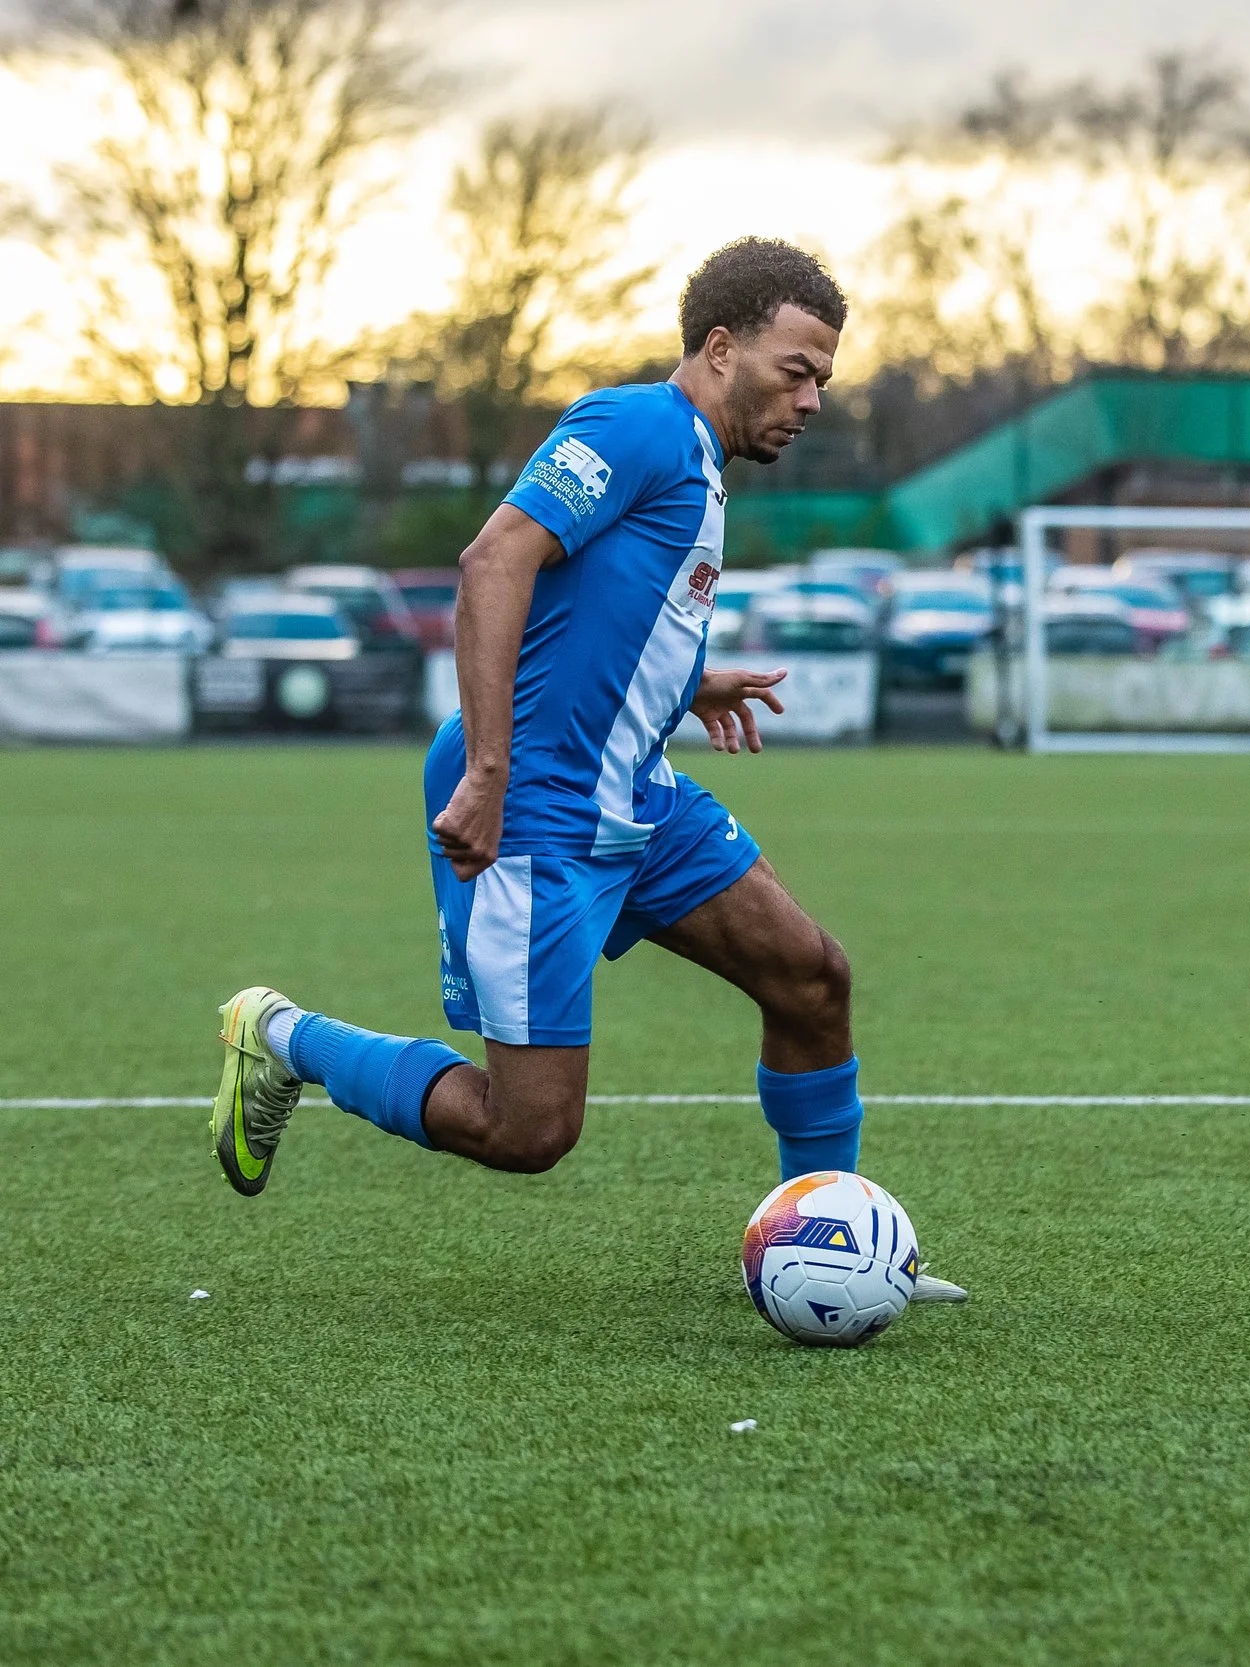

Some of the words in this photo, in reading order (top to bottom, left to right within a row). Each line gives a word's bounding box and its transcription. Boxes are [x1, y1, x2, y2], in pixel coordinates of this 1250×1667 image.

[526, 475, 553, 493] ANYTIME
[533, 468, 575, 500] COURIERS
[573, 497, 587, 515] LTD
[534, 460, 562, 478] CROSS
[561, 476, 596, 515] COUNTIES
